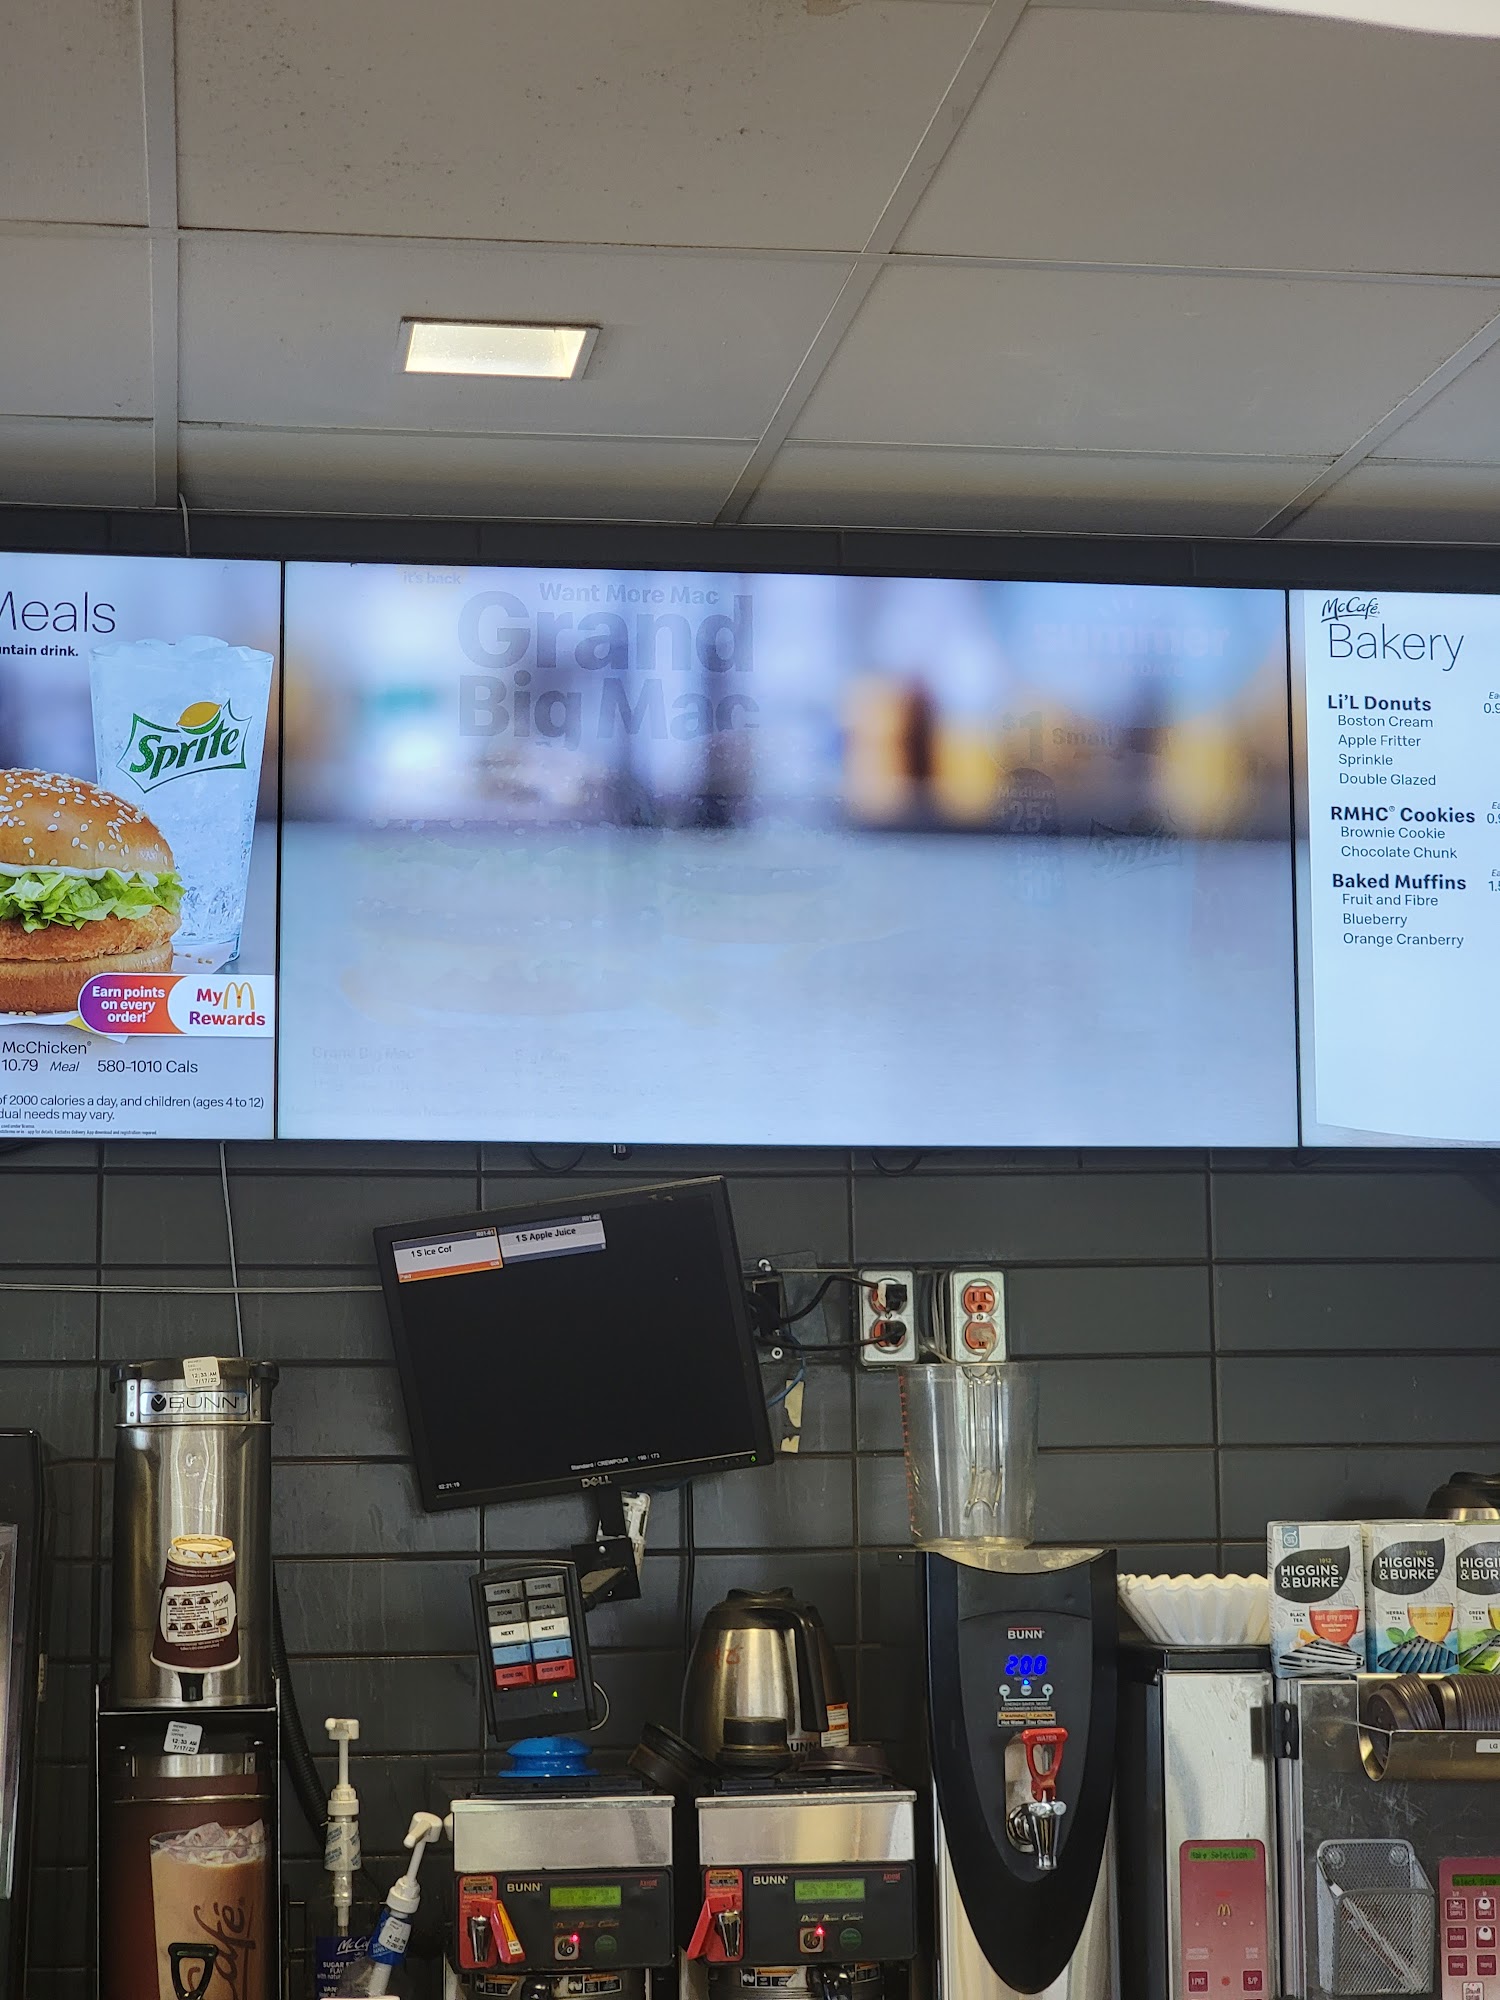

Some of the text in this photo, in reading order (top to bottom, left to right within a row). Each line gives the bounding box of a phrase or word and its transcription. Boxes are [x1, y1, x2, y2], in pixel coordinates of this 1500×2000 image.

[539, 583, 720, 605] Want More Mac
[457, 590, 753, 672] Grand
[0, 644, 79, 657] ntain drink.
[1329, 623, 1464, 671] Bakery
[1364, 695, 1432, 711] Donuts
[459, 670, 761, 750] Big Mac
[1338, 715, 1434, 728] Boston Cream
[1338, 734, 1421, 748] Apple Fritter
[129, 719, 240, 780] Sprite
[1338, 753, 1393, 767] Sprinkle
[1339, 773, 1436, 786] Double Glazed
[1400, 807, 1476, 823] Cookies
[1340, 826, 1446, 839] Brownie Cookie
[1341, 846, 1458, 859] Chocolate Chunk
[1332, 874, 1467, 890] Baked Muffins
[1342, 894, 1439, 906] Fruit and Fibre
[1343, 914, 1408, 928] Blueberry
[1343, 933, 1464, 949] Orange Cranberry
[92, 986, 166, 1001] Earn points
[196, 988, 223, 1006] My
[101, 1001, 156, 1014] on every
[189, 1011, 266, 1026] Rewards
[1, 1059, 198, 1073] 10.79 Meal 580-1010 Cals
[10, 1095, 38, 1106] 2000
[40, 1095, 85, 1106] calories
[88, 1098, 94, 1106] a
[97, 1096, 118, 1109] day,
[120, 1096, 142, 1107] and
[144, 1096, 190, 1108] children
[192, 1096, 224, 1110] (ages
[226, 1098, 232, 1108] 4
[234, 1098, 247, 1108] to
[248, 1097, 264, 1110] 12)
[24, 1109, 60, 1120] needs
[62, 1111, 88, 1122] may
[90, 1111, 116, 1122] vary.
[530, 1231, 552, 1242] Apple
[555, 1227, 576, 1238] Juice
[438, 1246, 452, 1254] Cof
[170, 1396, 237, 1408] BUNN
[581, 1475, 612, 1488] DELL
[1380, 1557, 1435, 1568] HIGGINS
[1460, 1558, 1500, 1568] HIGGI
[1280, 1565, 1339, 1576] HIGGINS
[1380, 1569, 1435, 1580] & BURKE
[1460, 1569, 1470, 1580] &
[1281, 1577, 1340, 1588] & BURKE
[1008, 1630, 1042, 1640] BUNN
[1005, 1655, 1048, 1675] 200
[791, 1742, 816, 1752] UNN
[752, 1876, 786, 1885] BUNN
[506, 1883, 541, 1892] BUNN
